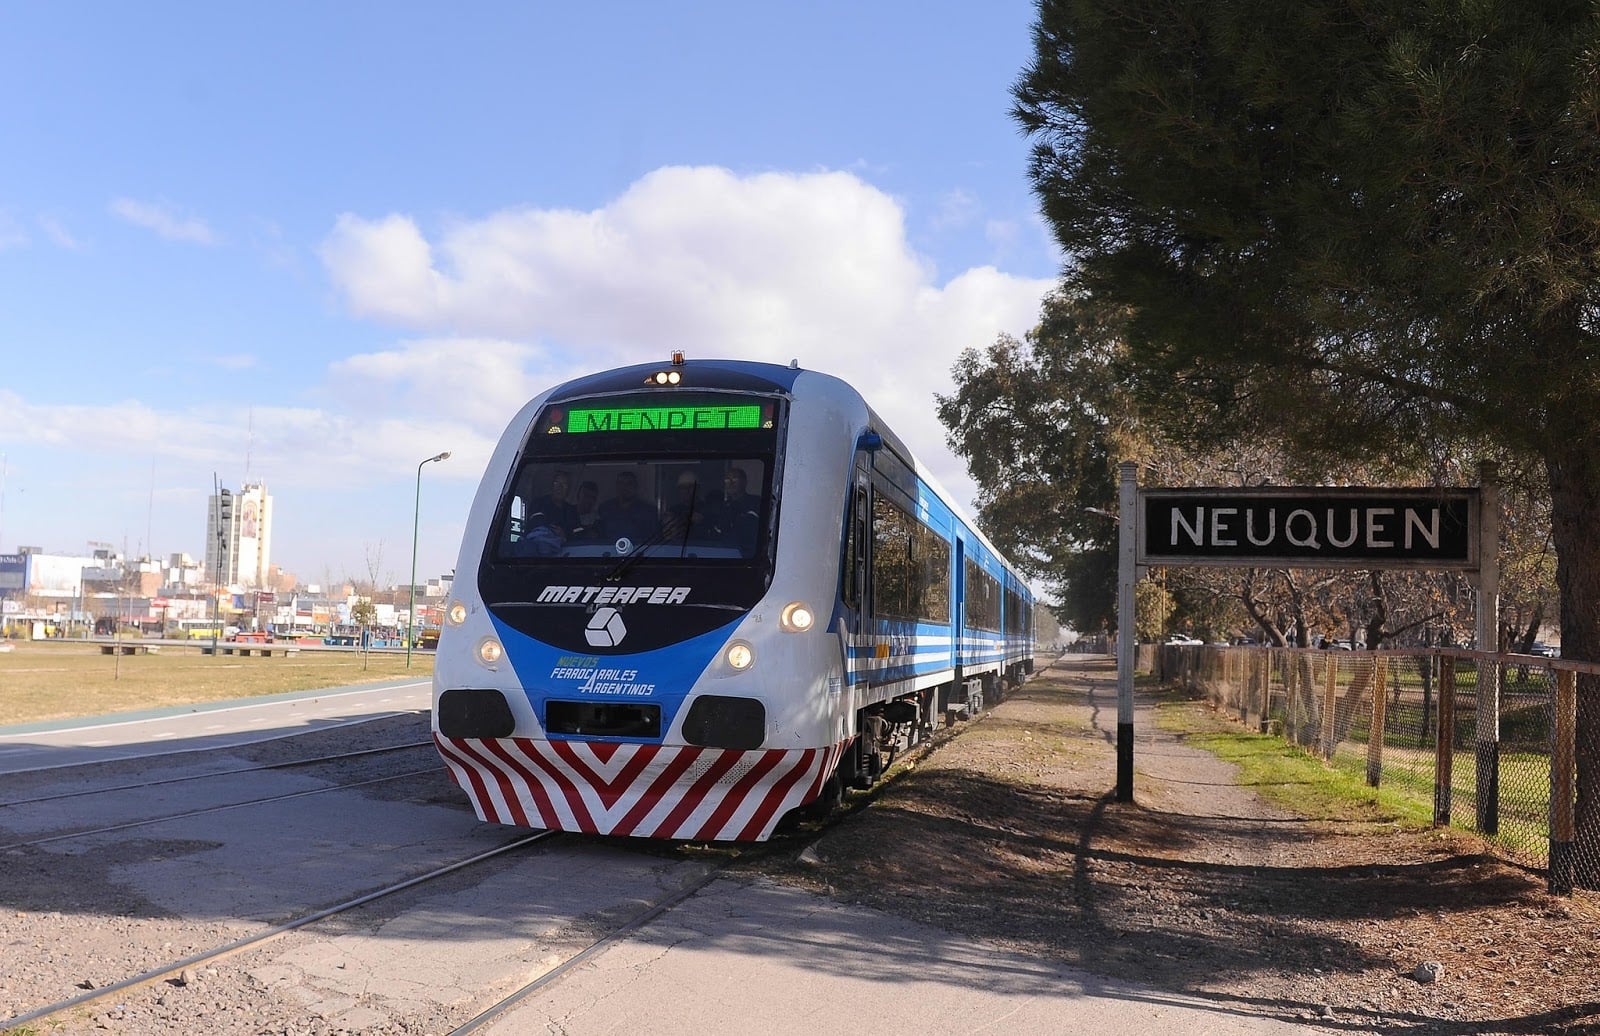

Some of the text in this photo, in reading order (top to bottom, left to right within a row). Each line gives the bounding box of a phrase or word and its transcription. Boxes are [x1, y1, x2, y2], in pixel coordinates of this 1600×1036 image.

[1170, 506, 1440, 550] NEUQUEN
[536, 585, 692, 604] MATERFER
[557, 656, 600, 667] NUEVOS
[551, 668, 638, 681] FERROCARRILES
[578, 677, 655, 696] ARGENTINOS
